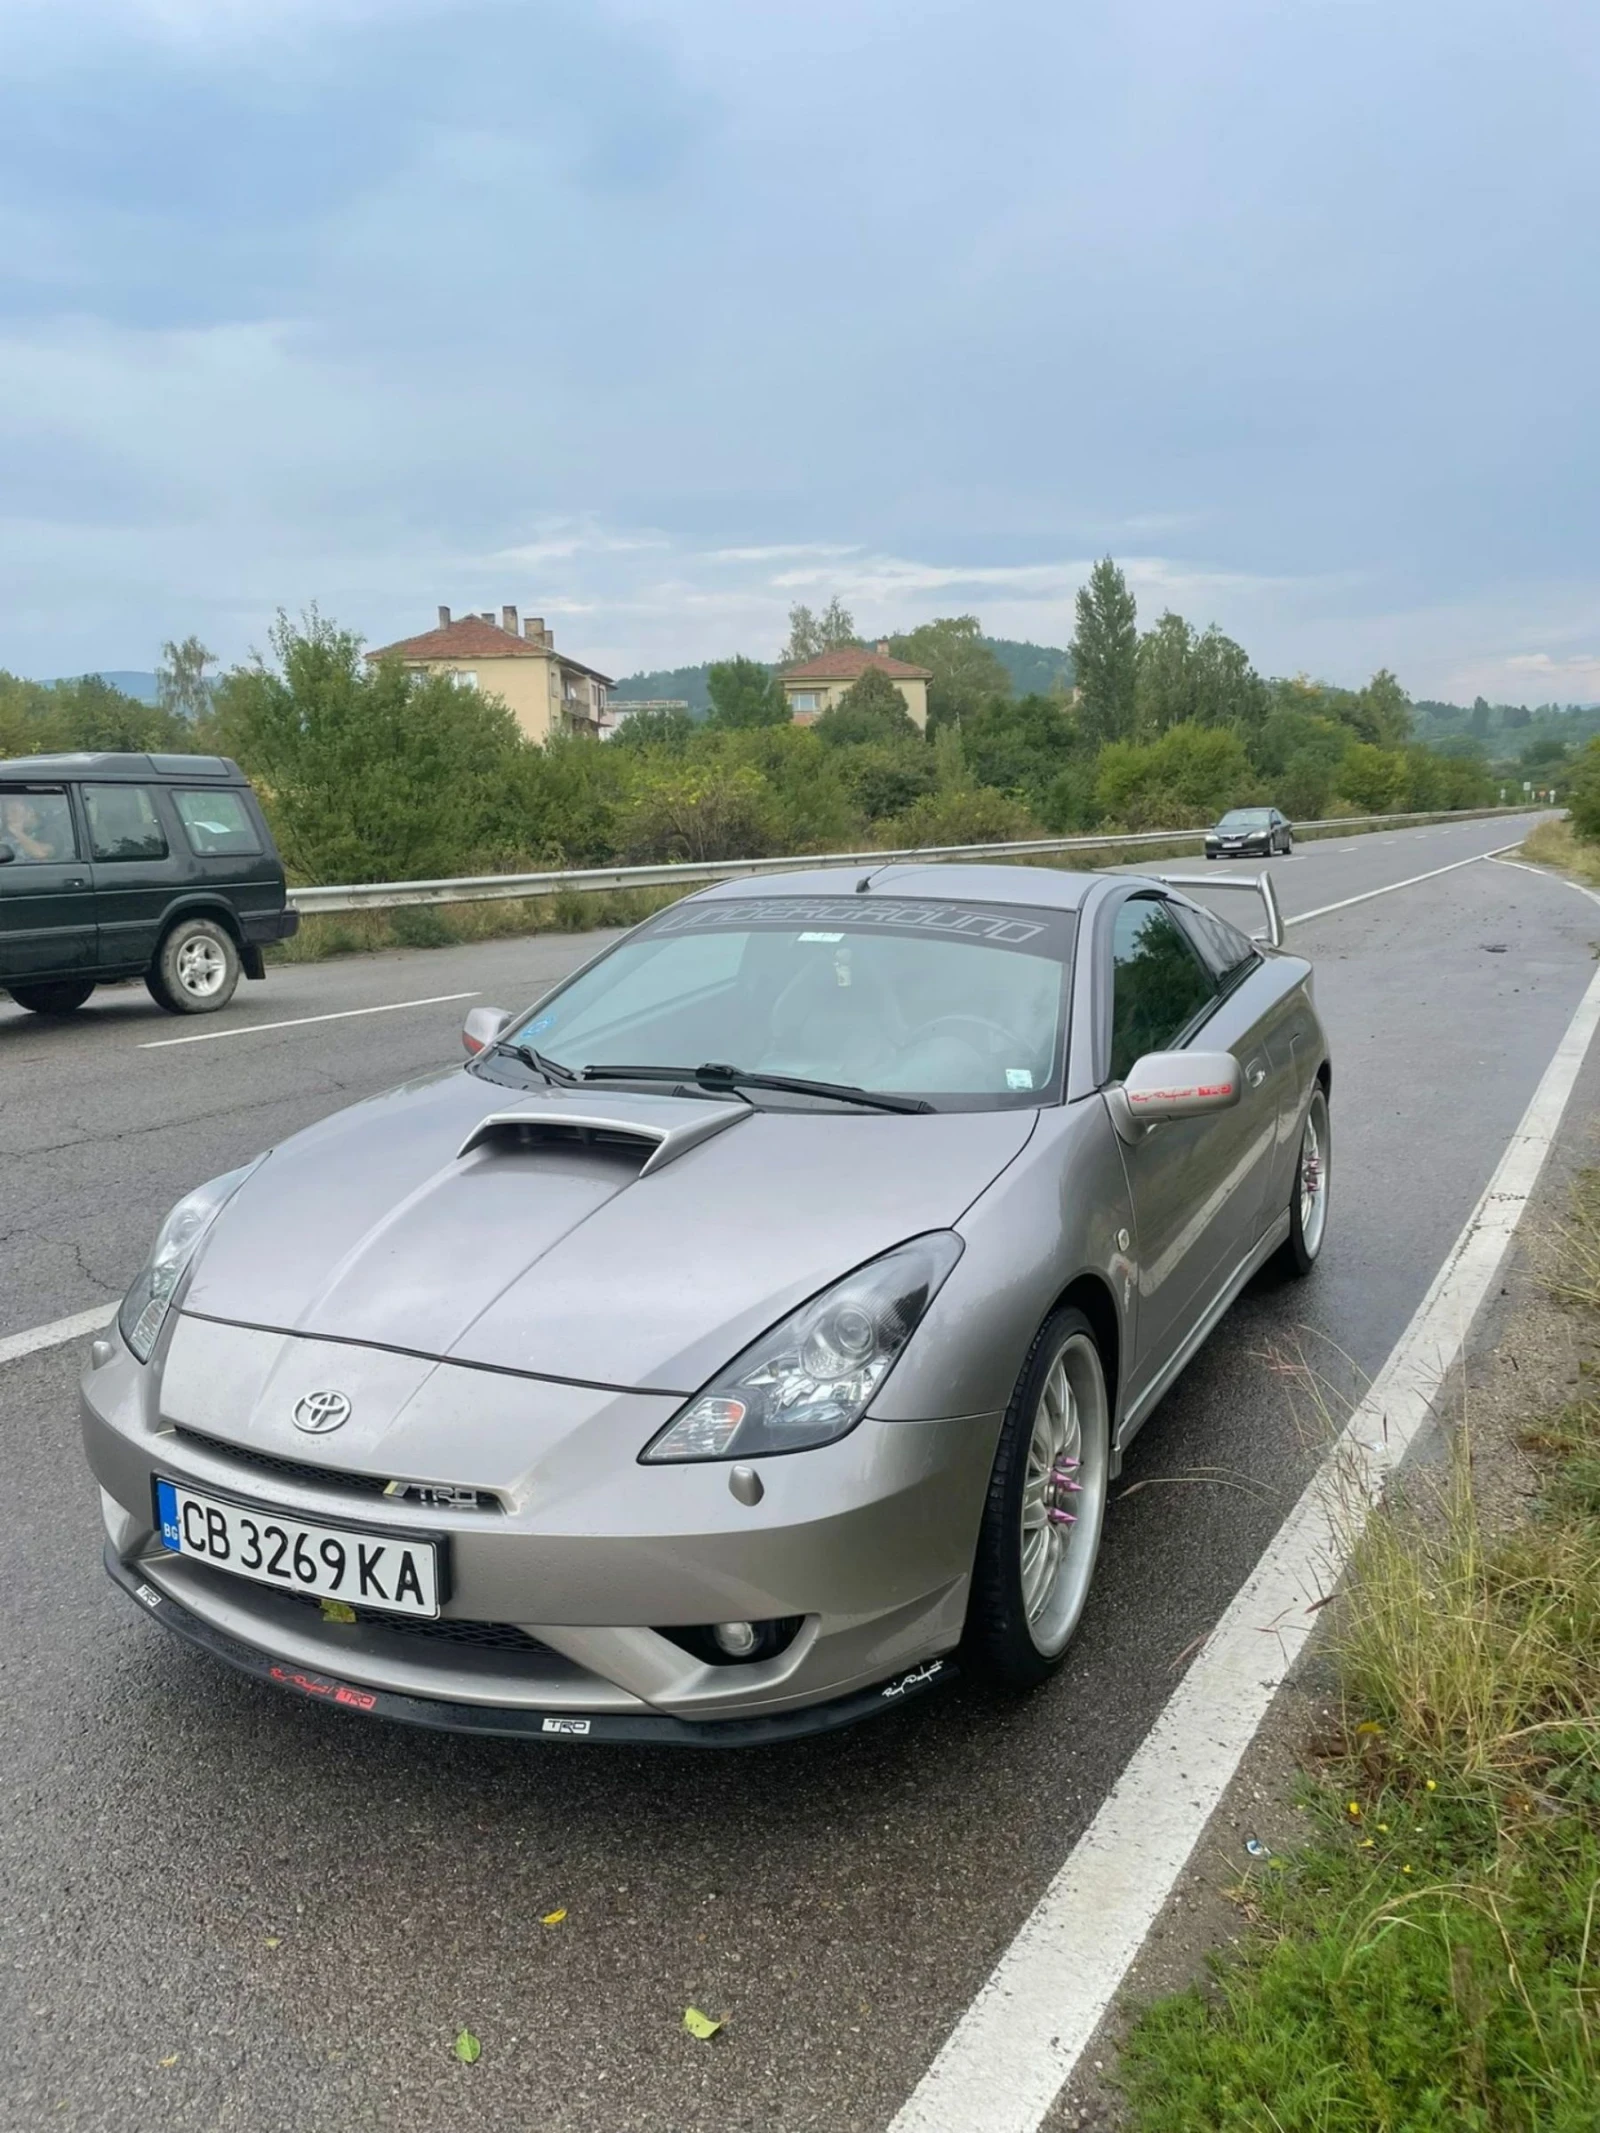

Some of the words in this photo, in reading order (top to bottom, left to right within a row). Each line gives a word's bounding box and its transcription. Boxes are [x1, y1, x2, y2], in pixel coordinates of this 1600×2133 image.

[653, 904, 1050, 943] UNDERGROUND
[409, 1483, 477, 1504] TRD
[163, 1522, 179, 1541] BG
[182, 1500, 230, 1560] CB
[240, 1518, 346, 1591] 3269
[357, 1543, 425, 1606] KA
[547, 1719, 587, 1734] TRD
